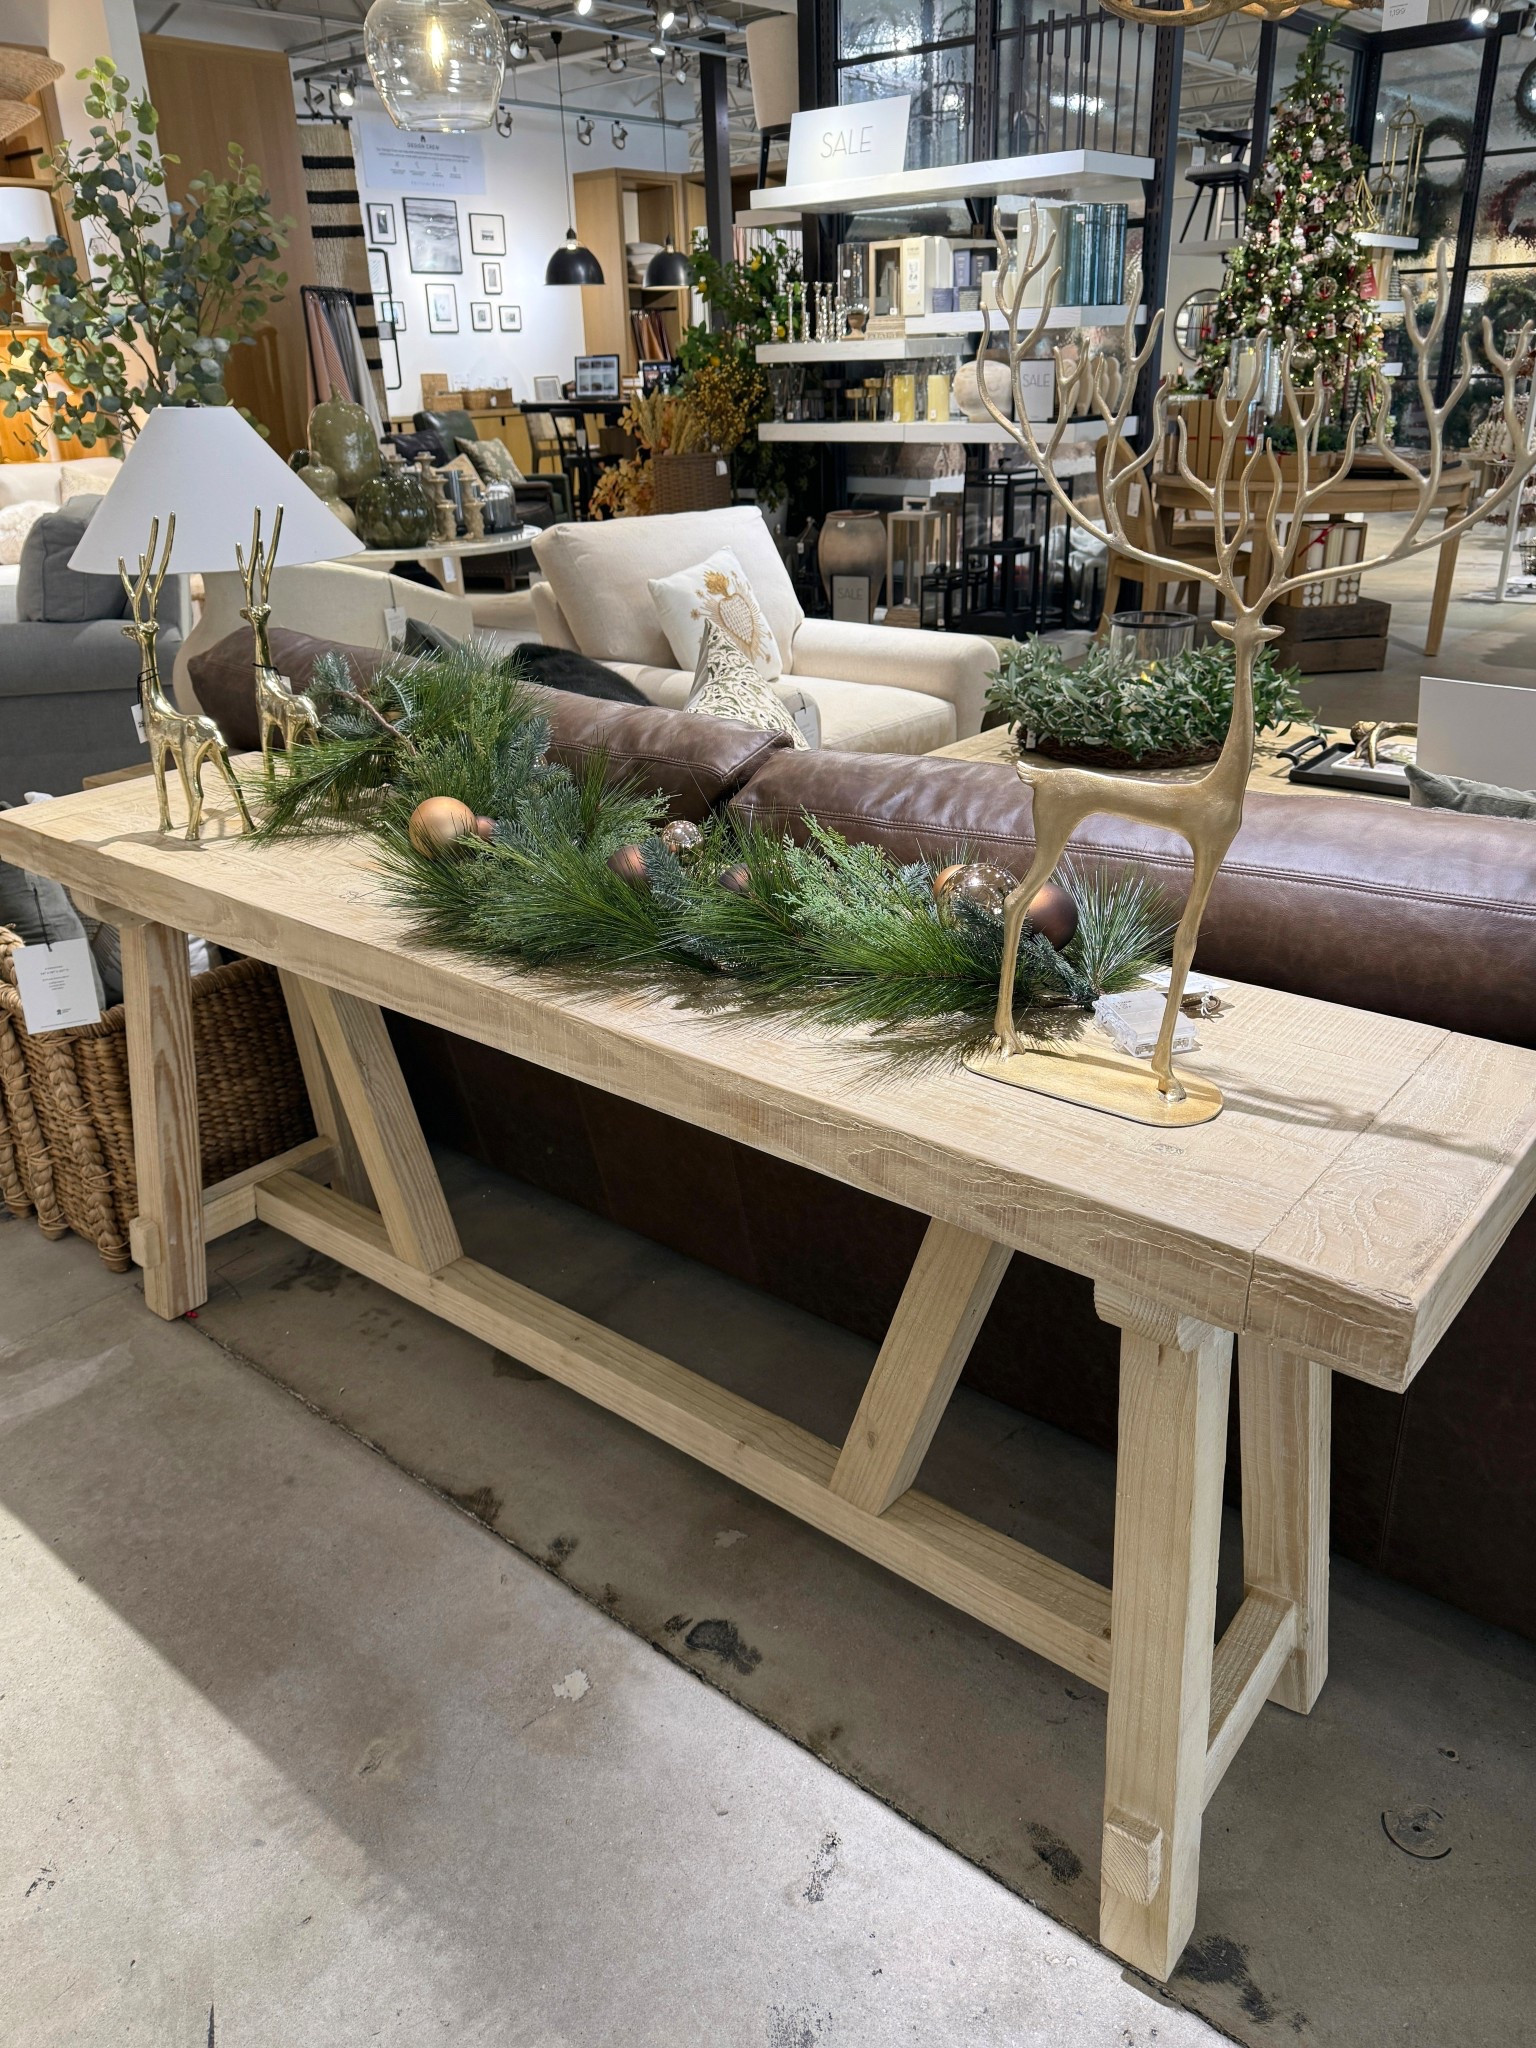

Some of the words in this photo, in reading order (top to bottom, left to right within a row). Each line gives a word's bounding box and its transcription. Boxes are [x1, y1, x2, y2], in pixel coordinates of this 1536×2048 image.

[820, 125, 874, 158] SALE
[1022, 373, 1051, 388] SALE
[837, 587, 864, 600] SALE
